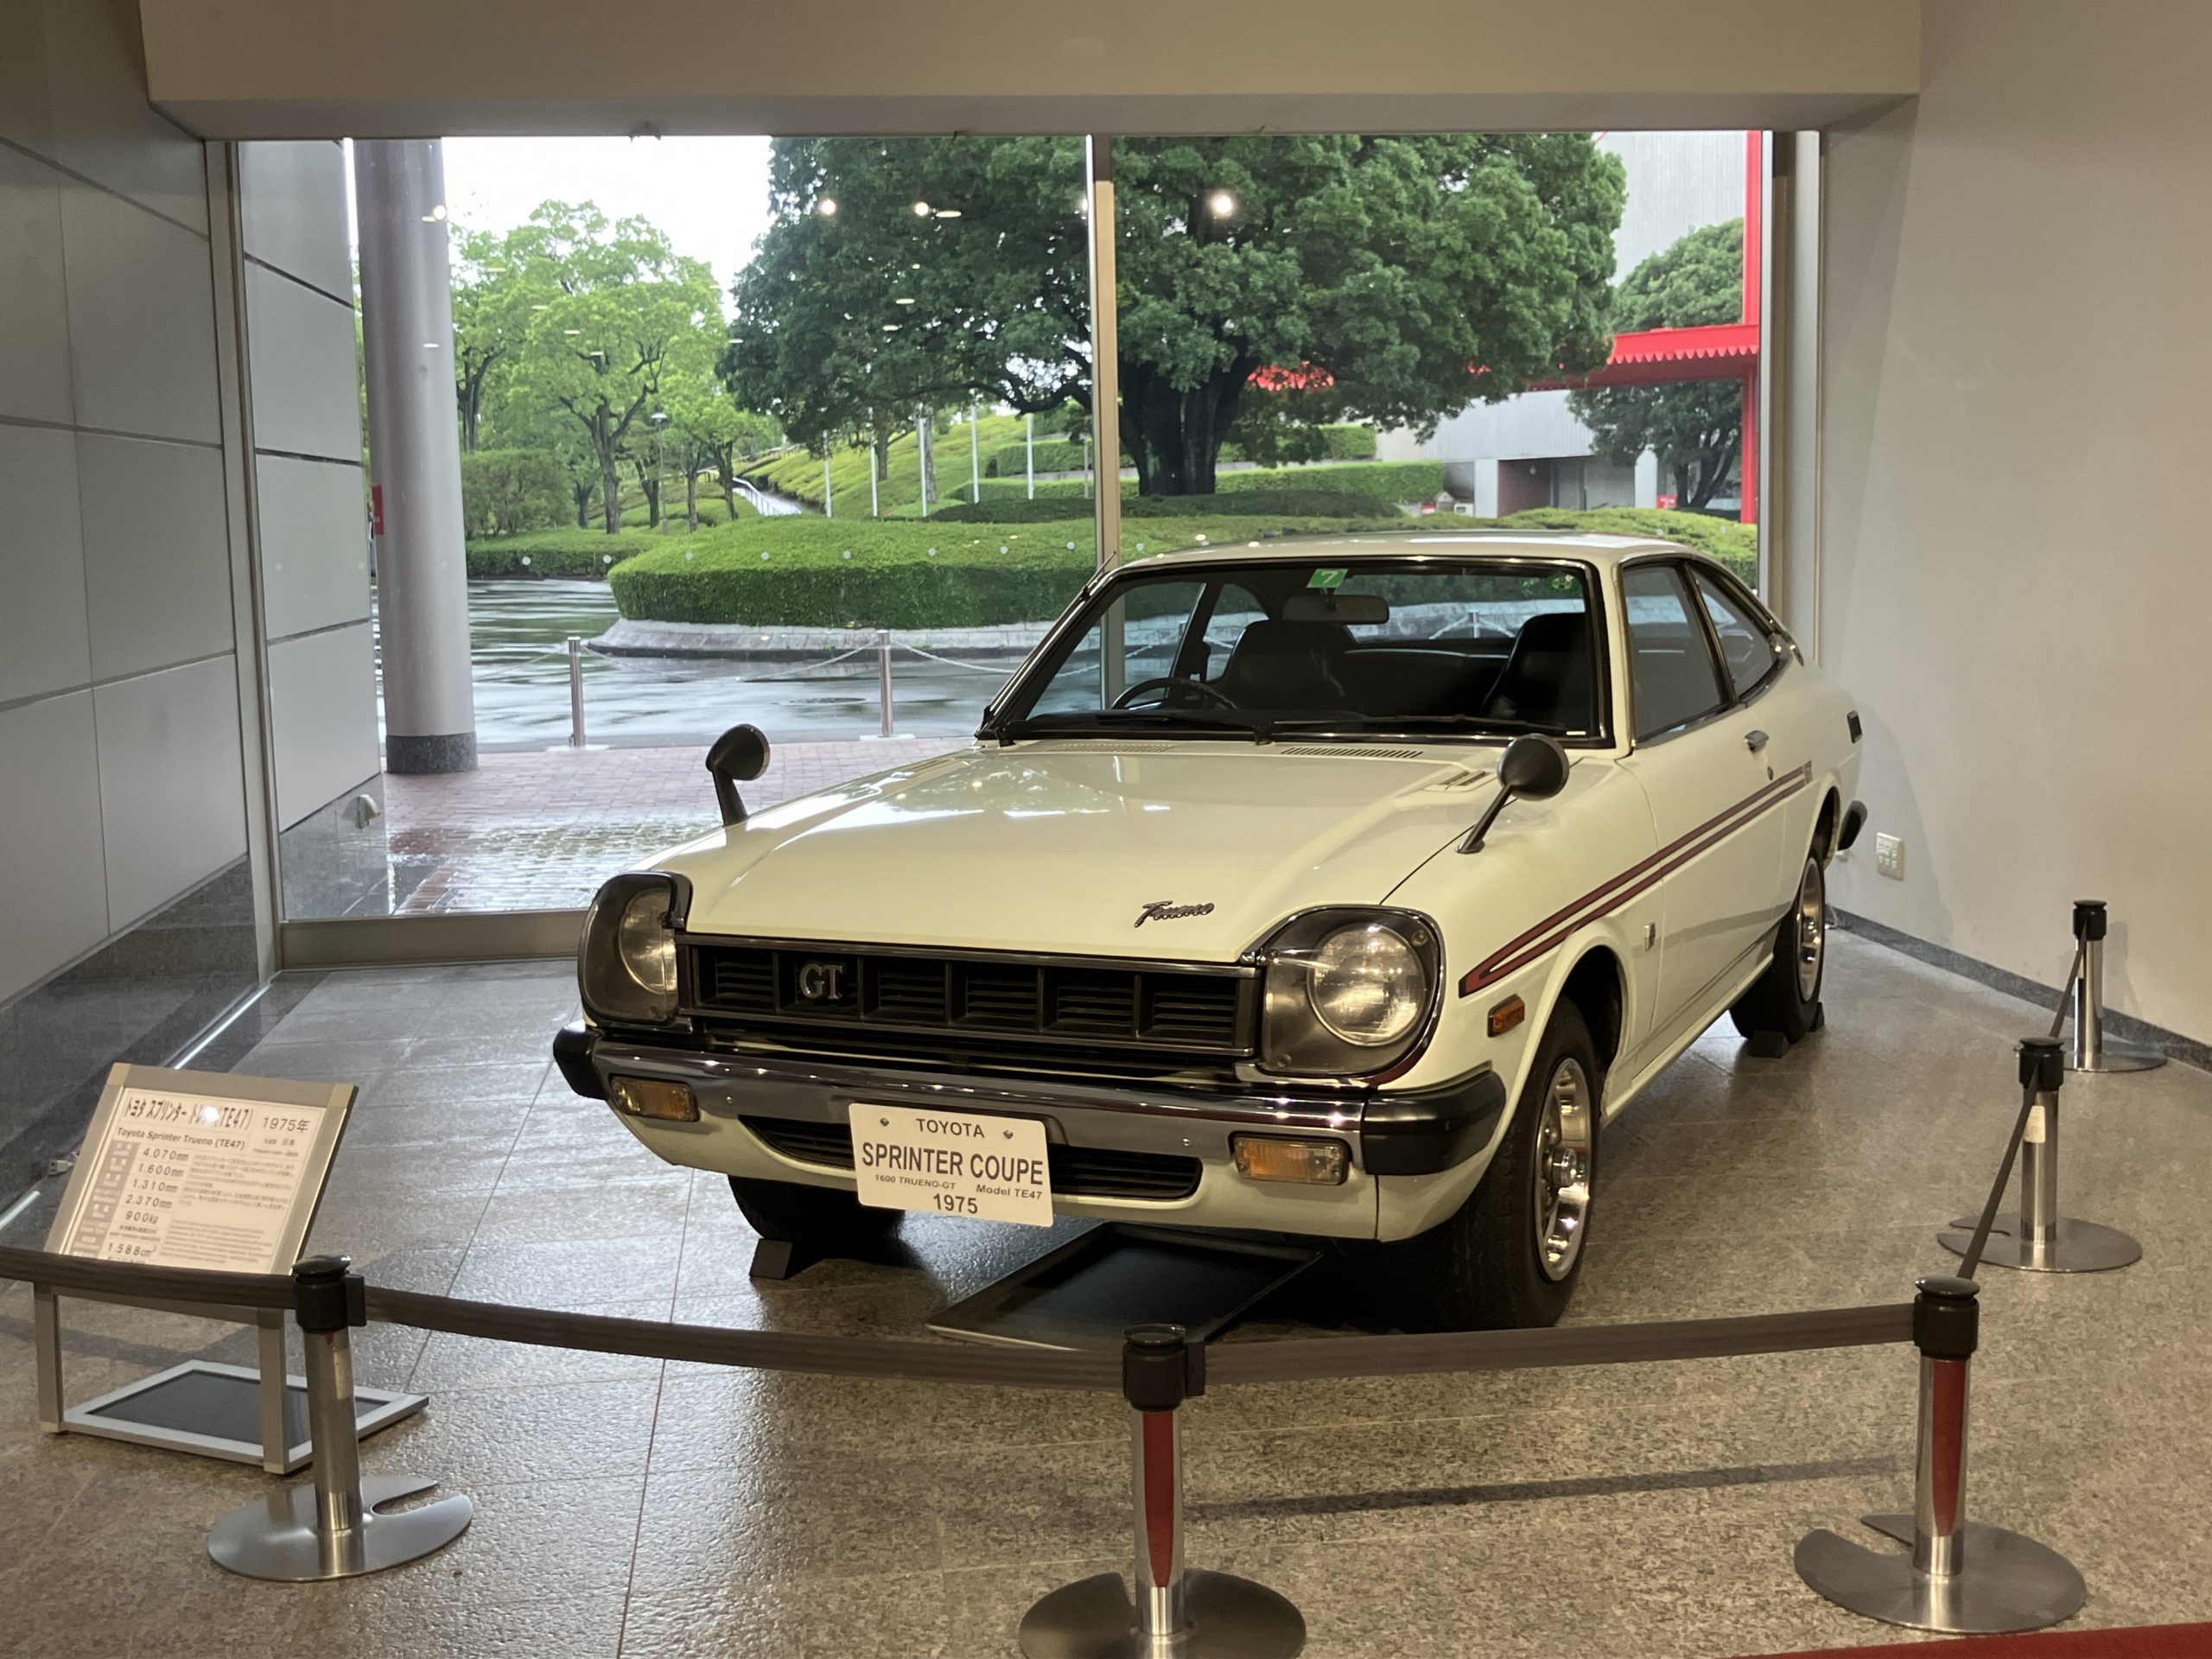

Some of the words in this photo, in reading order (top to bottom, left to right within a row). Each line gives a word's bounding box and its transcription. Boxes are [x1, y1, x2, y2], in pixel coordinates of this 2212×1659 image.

[1320, 570, 1338, 584] 7
[799, 963, 843, 1000] GT
[124, 1096, 146, 1118] トヨタ
[146, 1099, 188, 1122] スプリンター
[263, 1116, 310, 1134] 1975年
[916, 1118, 985, 1138] TOYOTA
[118, 1127, 145, 1139] Toyota
[146, 1130, 181, 1142] Sprinter
[183, 1135, 213, 1146] Trueno
[214, 1138, 245, 1150] (TE47)
[862, 1141, 963, 1176] SPRINTER
[970, 1154, 1044, 1185] COUPE
[875, 1174, 896, 1183] 1600
[899, 1176, 957, 1190] TRUENO-GT
[976, 1184, 1010, 1197] Model
[1014, 1188, 1043, 1200] TE47
[933, 1193, 978, 1214] 1975
[125, 1211, 159, 1225] 900kg
